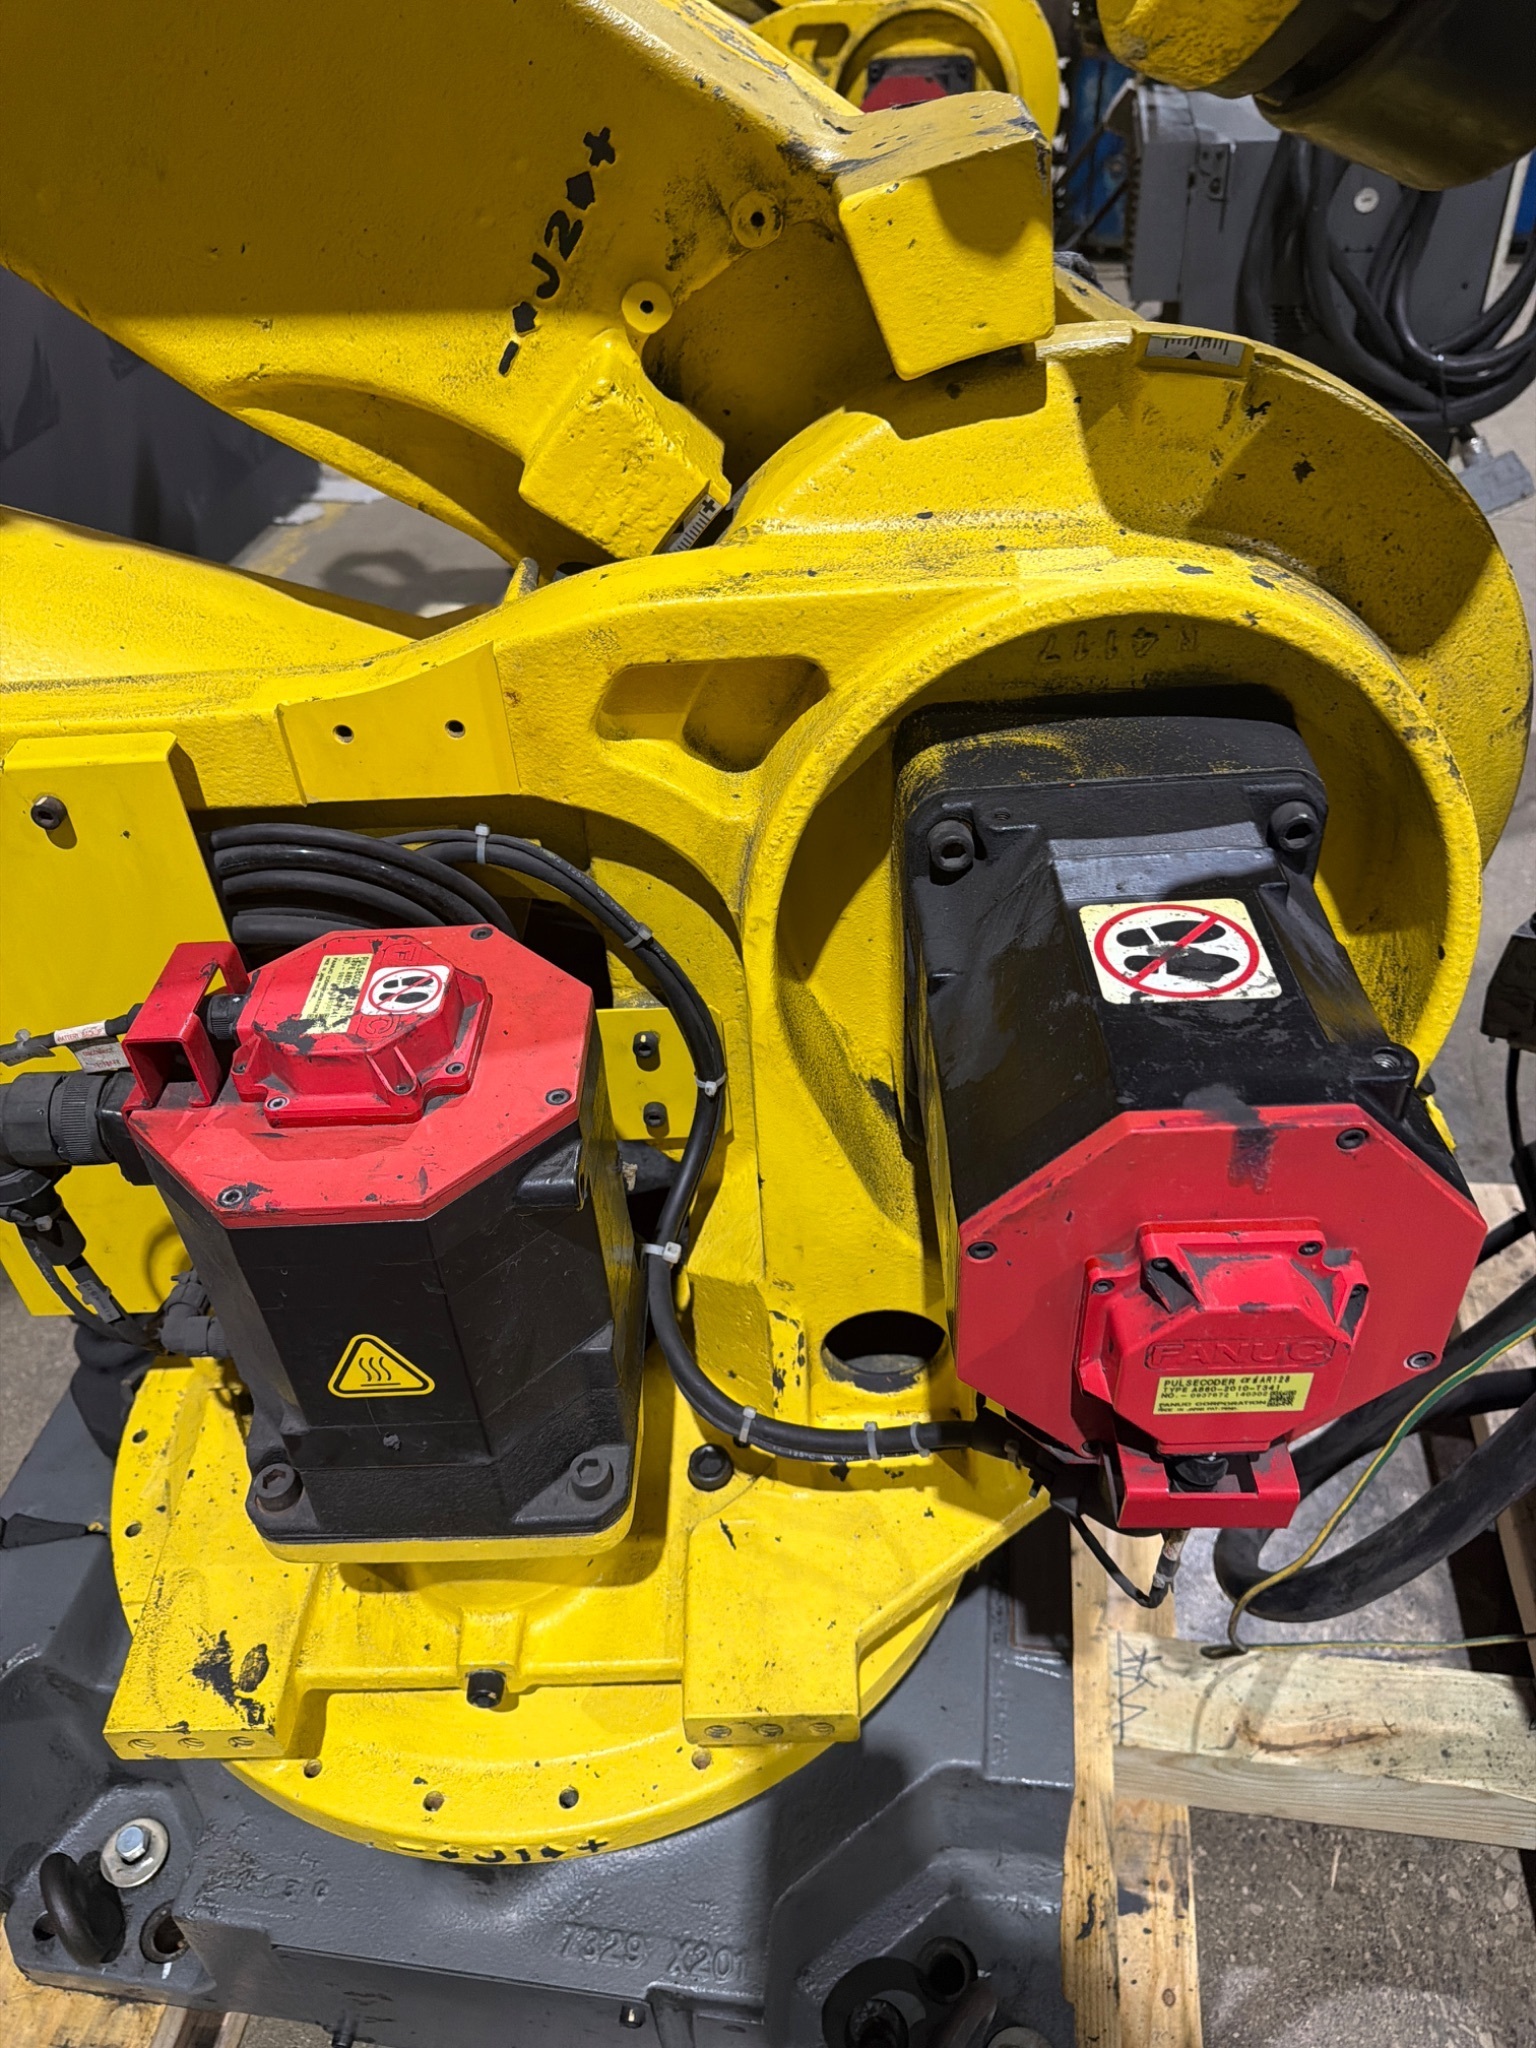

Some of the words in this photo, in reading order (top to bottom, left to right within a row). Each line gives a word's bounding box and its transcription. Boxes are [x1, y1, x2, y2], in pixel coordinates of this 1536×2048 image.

[531, 209, 585, 300] J2
[1150, 1341, 1327, 1367] FANUC
[1164, 1378, 1236, 1387] PULSECODER
